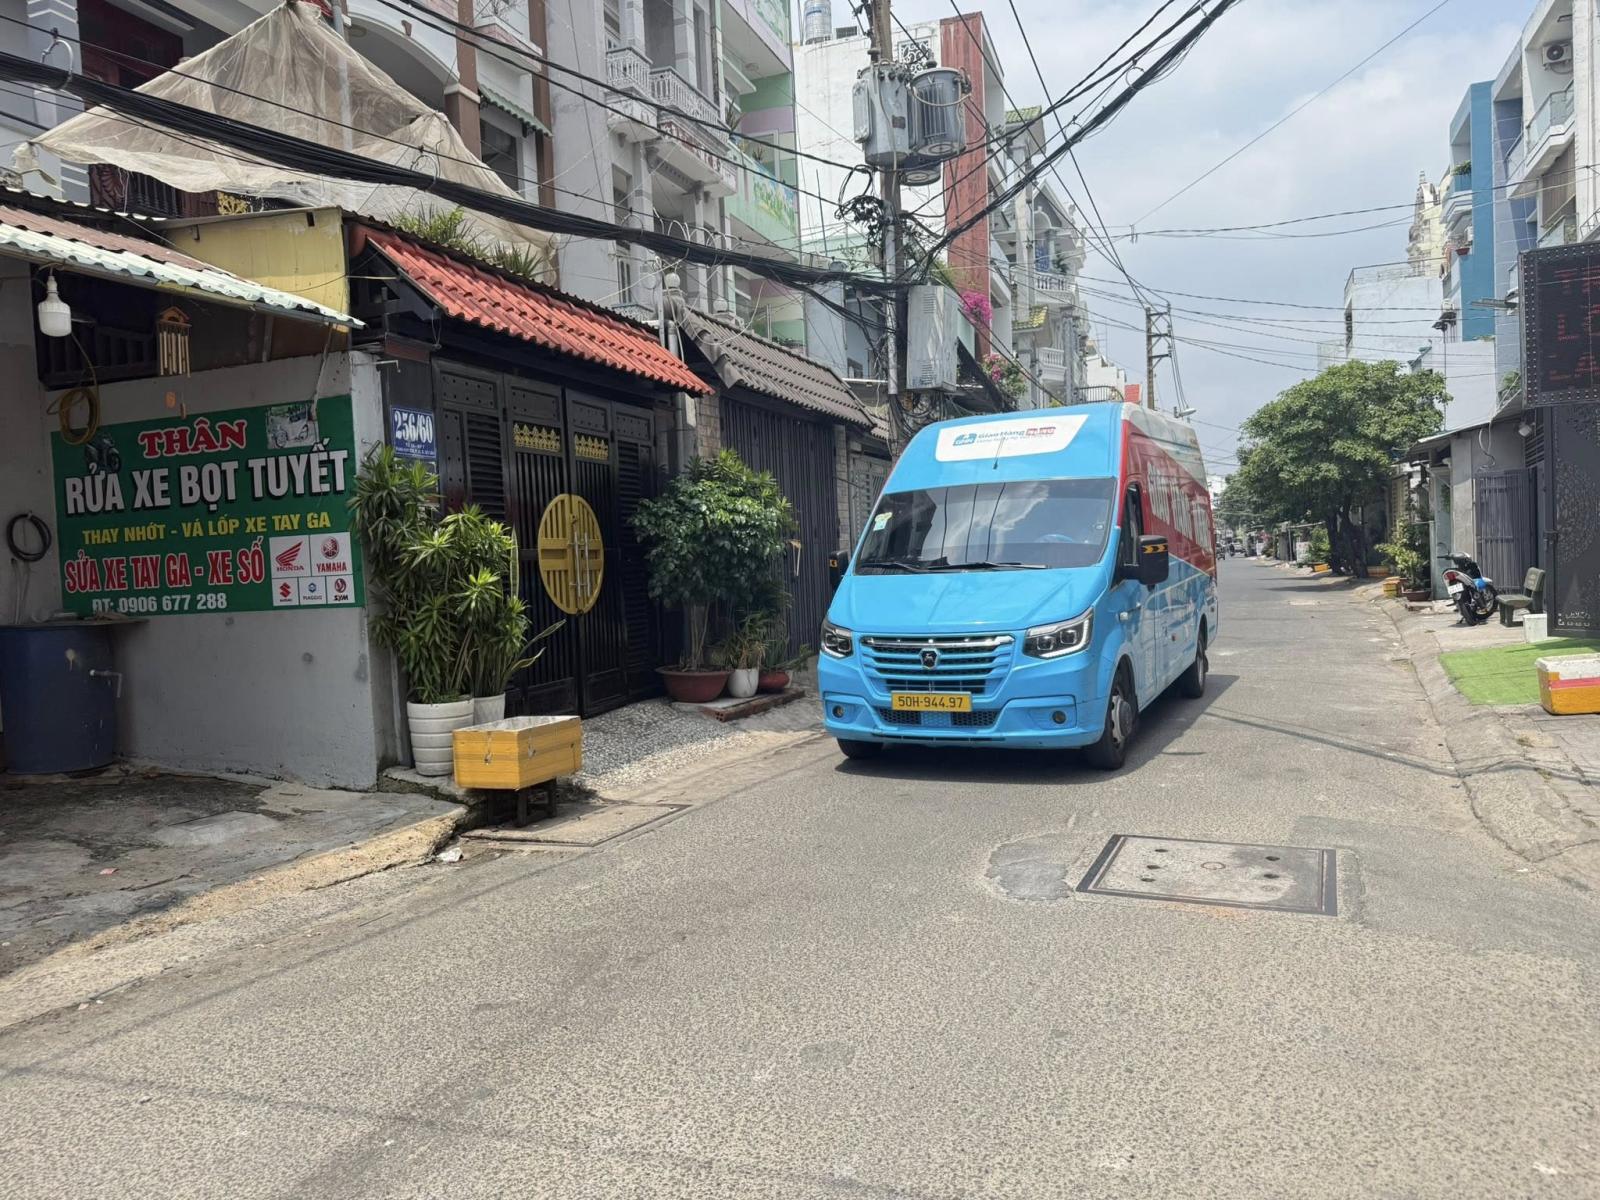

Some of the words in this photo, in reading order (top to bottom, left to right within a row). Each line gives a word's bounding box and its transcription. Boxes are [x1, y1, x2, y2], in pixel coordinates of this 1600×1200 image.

[138, 417, 247, 458] THÂN
[394, 410, 433, 443] 256/60
[65, 462, 125, 514] RỬA
[132, 468, 171, 508] XE
[180, 460, 239, 511] BỌT
[248, 437, 348, 498] TUYẾT
[82, 528, 119, 545] THAY
[124, 522, 166, 541] NHỚT
[182, 518, 203, 538] VÁ
[208, 514, 240, 536] LỐP
[245, 516, 267, 533] XE
[272, 514, 300, 531] TAY
[307, 512, 331, 529] GA
[64, 549, 101, 593] SỬA
[103, 557, 128, 591] XE
[129, 554, 160, 590] TAY
[165, 553, 192, 588] GA
[207, 550, 234, 585] XE
[236, 536, 266, 584] SỐ
[316, 561, 347, 573] YAMAHA
[119, 596, 158, 613] 0906
[162, 594, 191, 611] 677
[196, 592, 228, 610] 288
[897, 695, 963, 708] 50H-944.97
